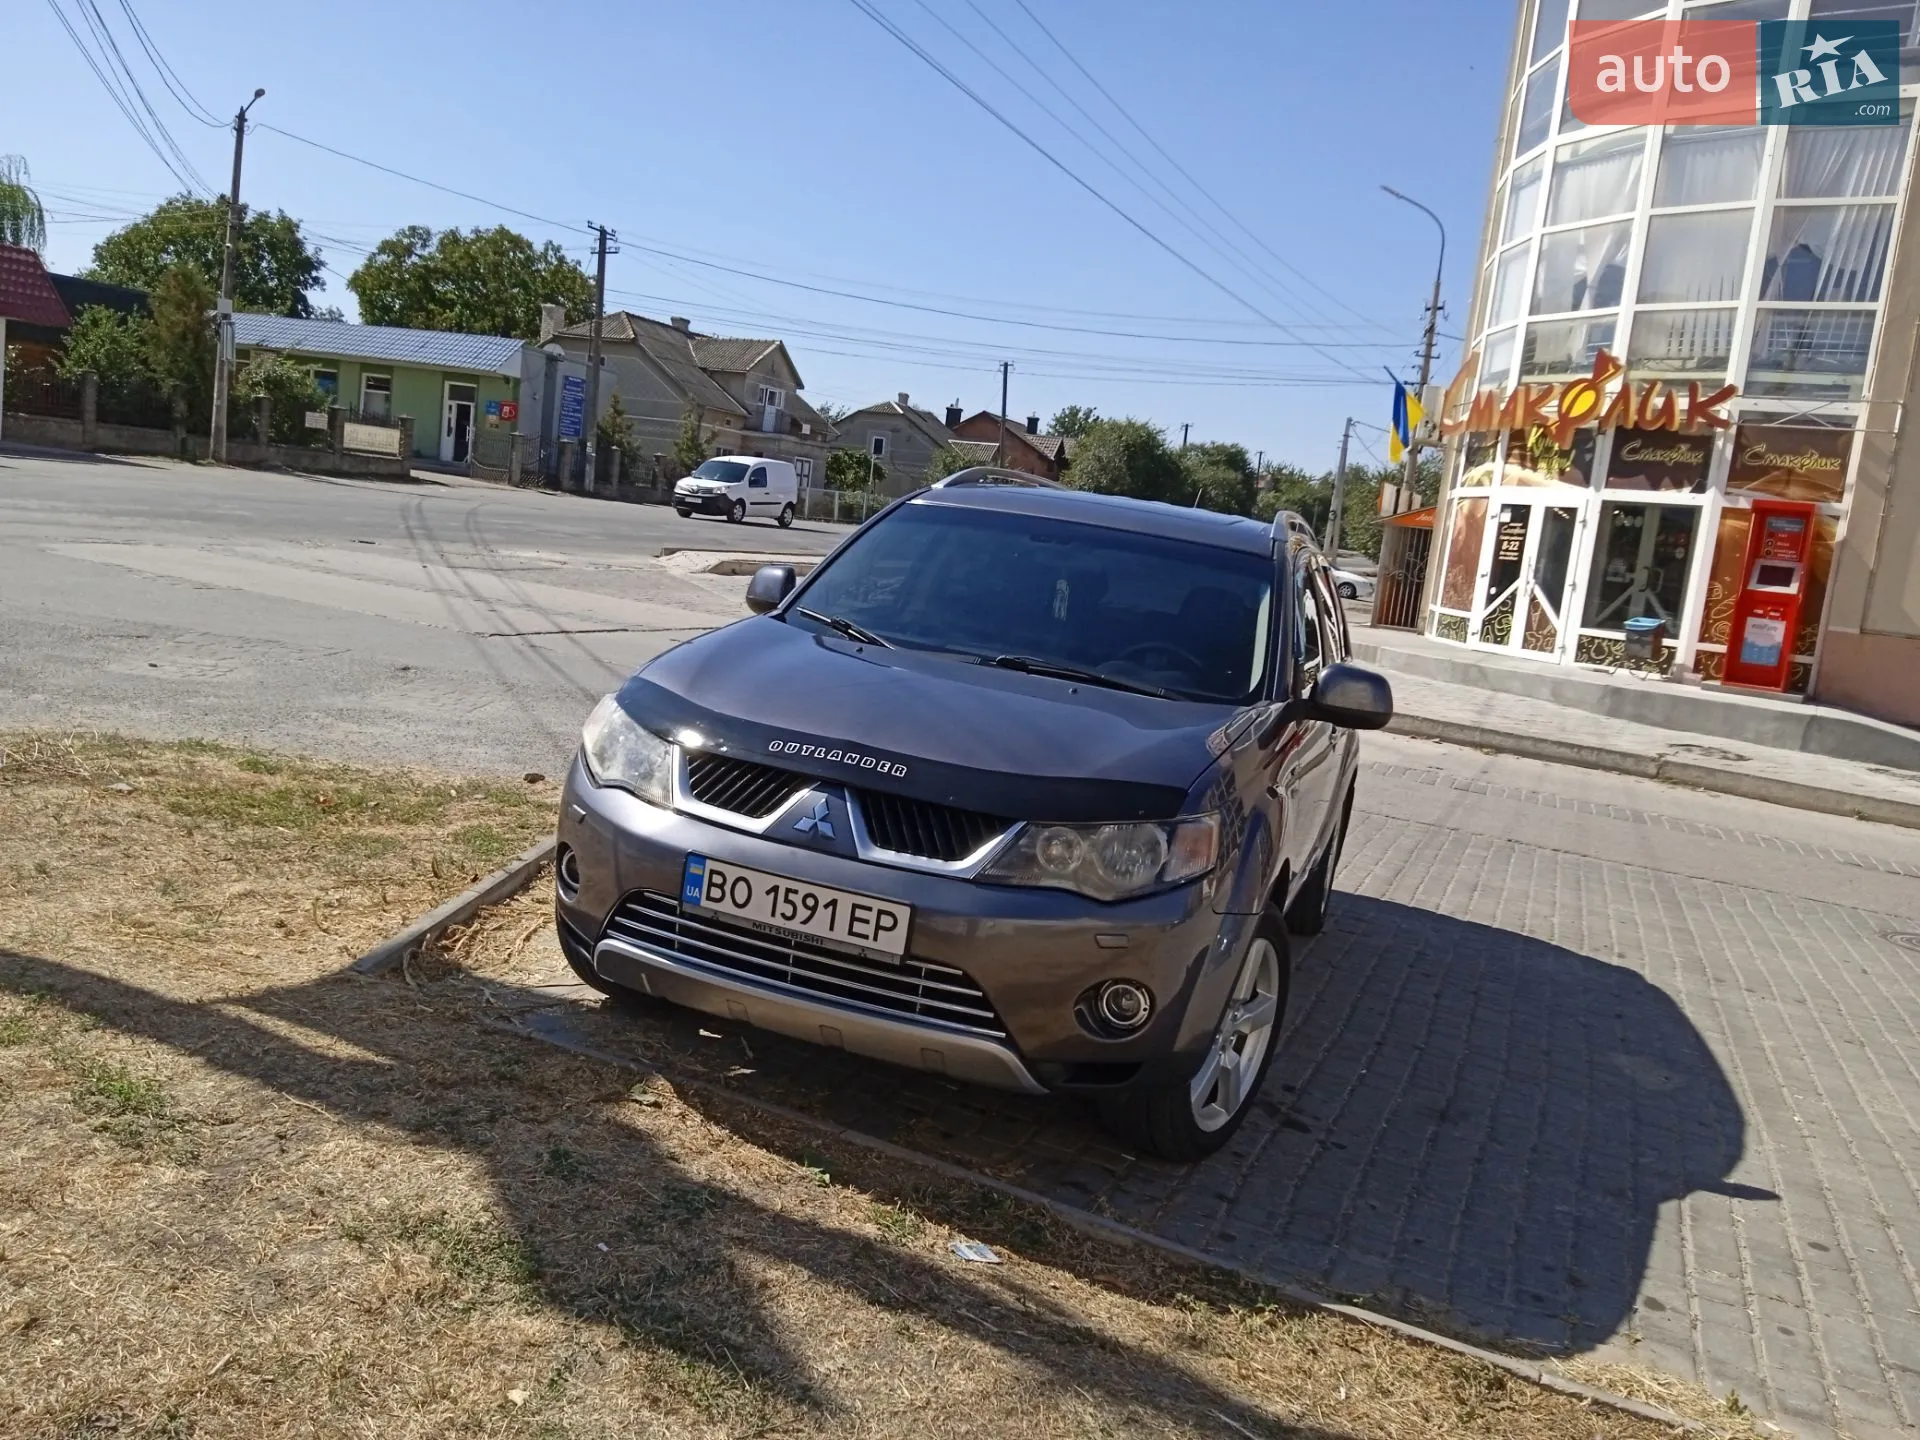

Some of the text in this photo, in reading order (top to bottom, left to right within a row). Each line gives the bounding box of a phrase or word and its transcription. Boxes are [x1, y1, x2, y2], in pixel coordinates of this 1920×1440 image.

[768, 740, 908, 778] OUTLANDER
[686, 884, 700, 898] UA
[705, 868, 899, 942] BO 1591 EP
[752, 921, 824, 946] MITSUBISHI
